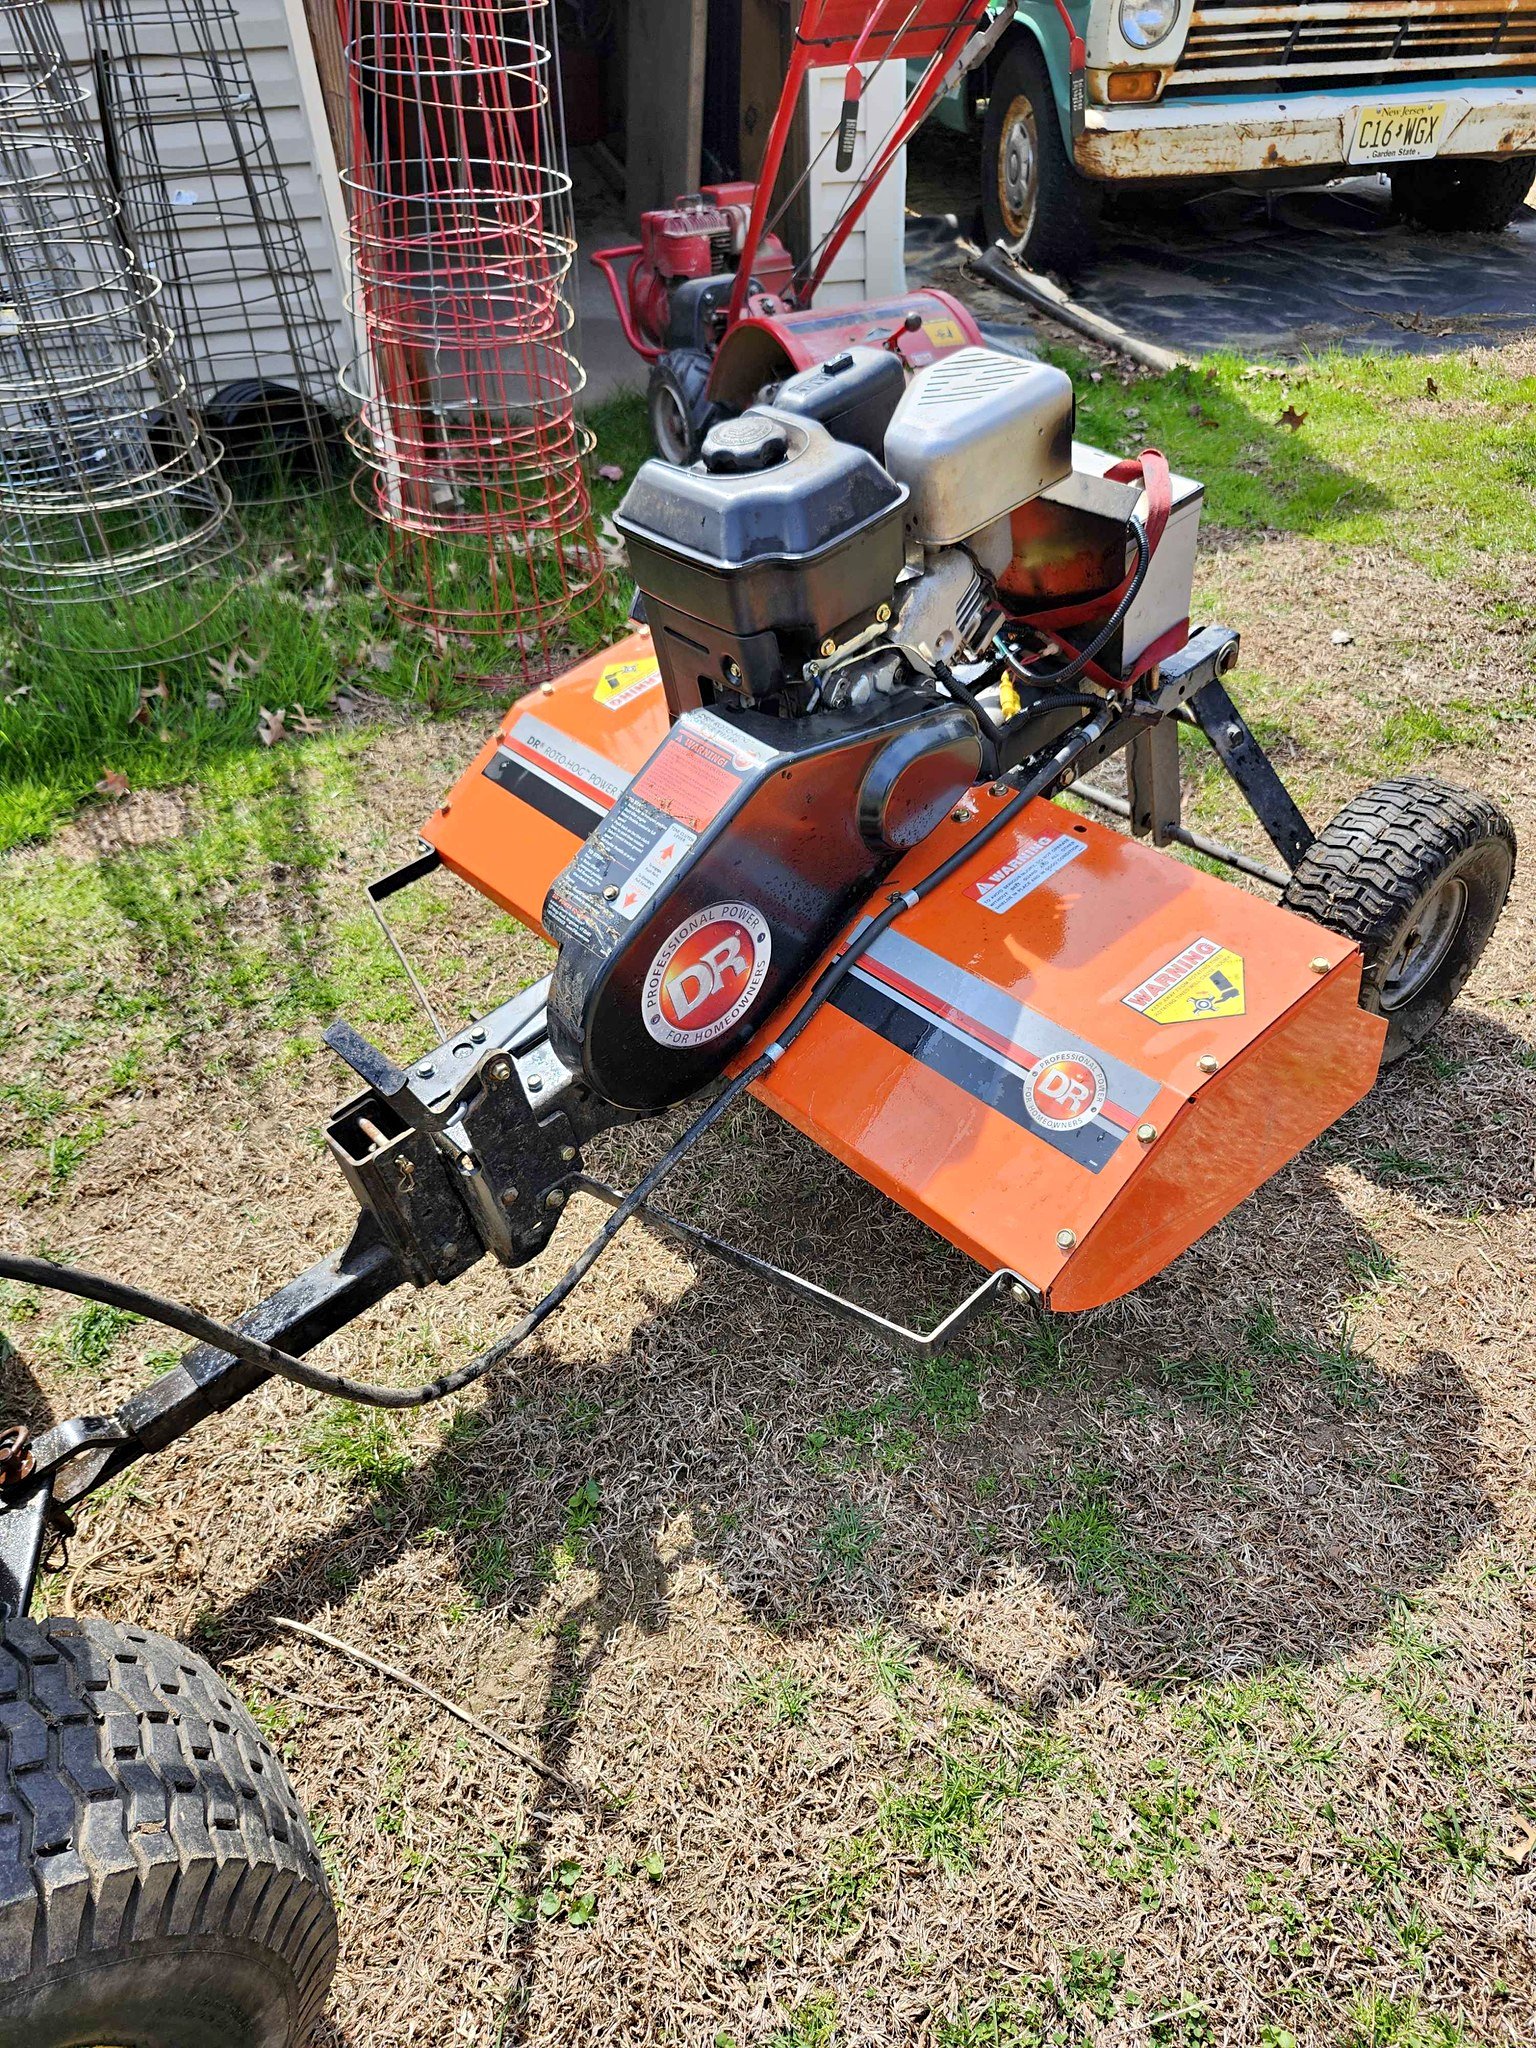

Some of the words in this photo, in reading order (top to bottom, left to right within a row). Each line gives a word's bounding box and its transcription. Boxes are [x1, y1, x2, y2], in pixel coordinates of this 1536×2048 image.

[1380, 107, 1400, 117] New
[1400, 106, 1427, 117] Jersey
[1371, 149, 1396, 158] Garden
[1398, 148, 1417, 157] State
[609, 671, 661, 706] ARNING
[683, 738, 729, 767] WARNING!
[587, 772, 619, 796] POWER
[988, 836, 1052, 882] WARNING
[647, 911, 715, 1008] PROFESSIONAL
[721, 906, 760, 929] POWER
[1126, 939, 1218, 1008] WARNING
[666, 1030, 690, 1044] FOR
[695, 960, 766, 1043] HOMEOWNERS
[1040, 1053, 1097, 1072] PROFESSIONAL
[1097, 1073, 1105, 1102] POWER
[1029, 1106, 1083, 1128] HOMEOWNERS
